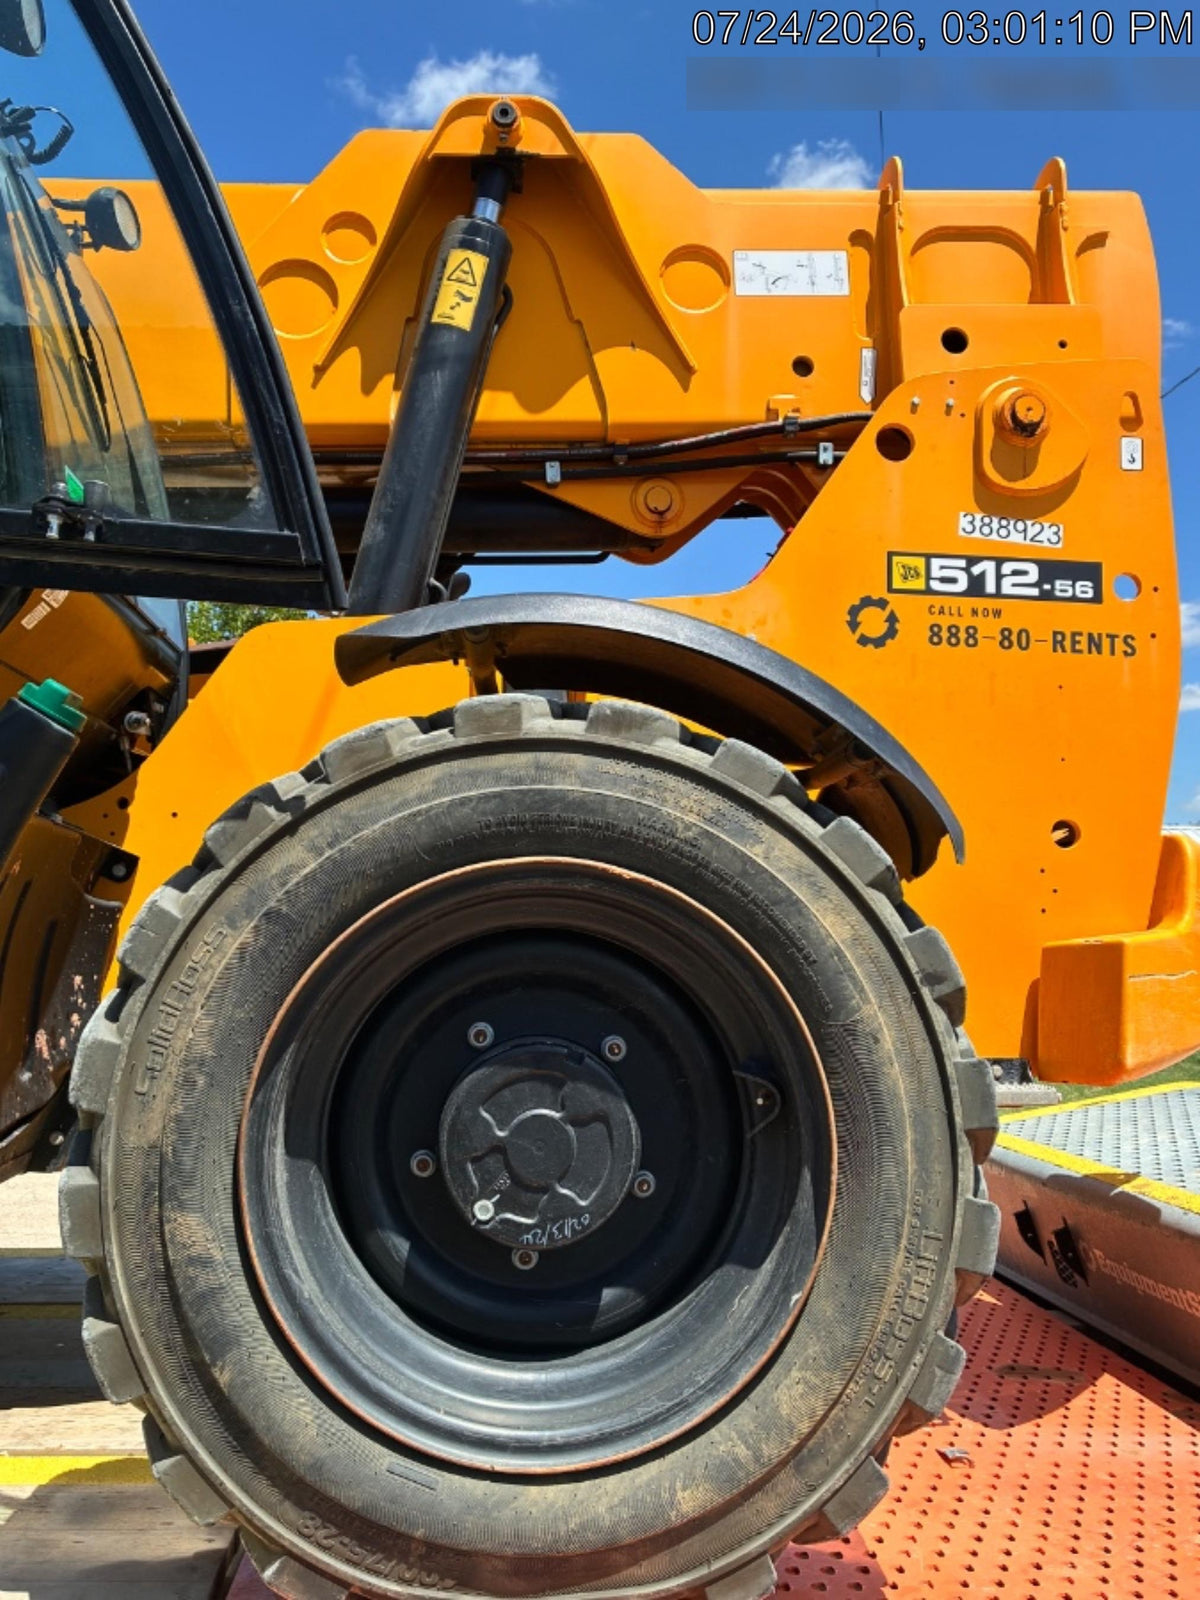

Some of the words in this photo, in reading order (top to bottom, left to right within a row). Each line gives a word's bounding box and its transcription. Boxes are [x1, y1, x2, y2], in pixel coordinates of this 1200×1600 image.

[961, 513, 1062, 546] 388923
[928, 604, 964, 618] CALL
[971, 607, 1003, 620] NOW
[928, 623, 1137, 658] 888-80-RENTS
